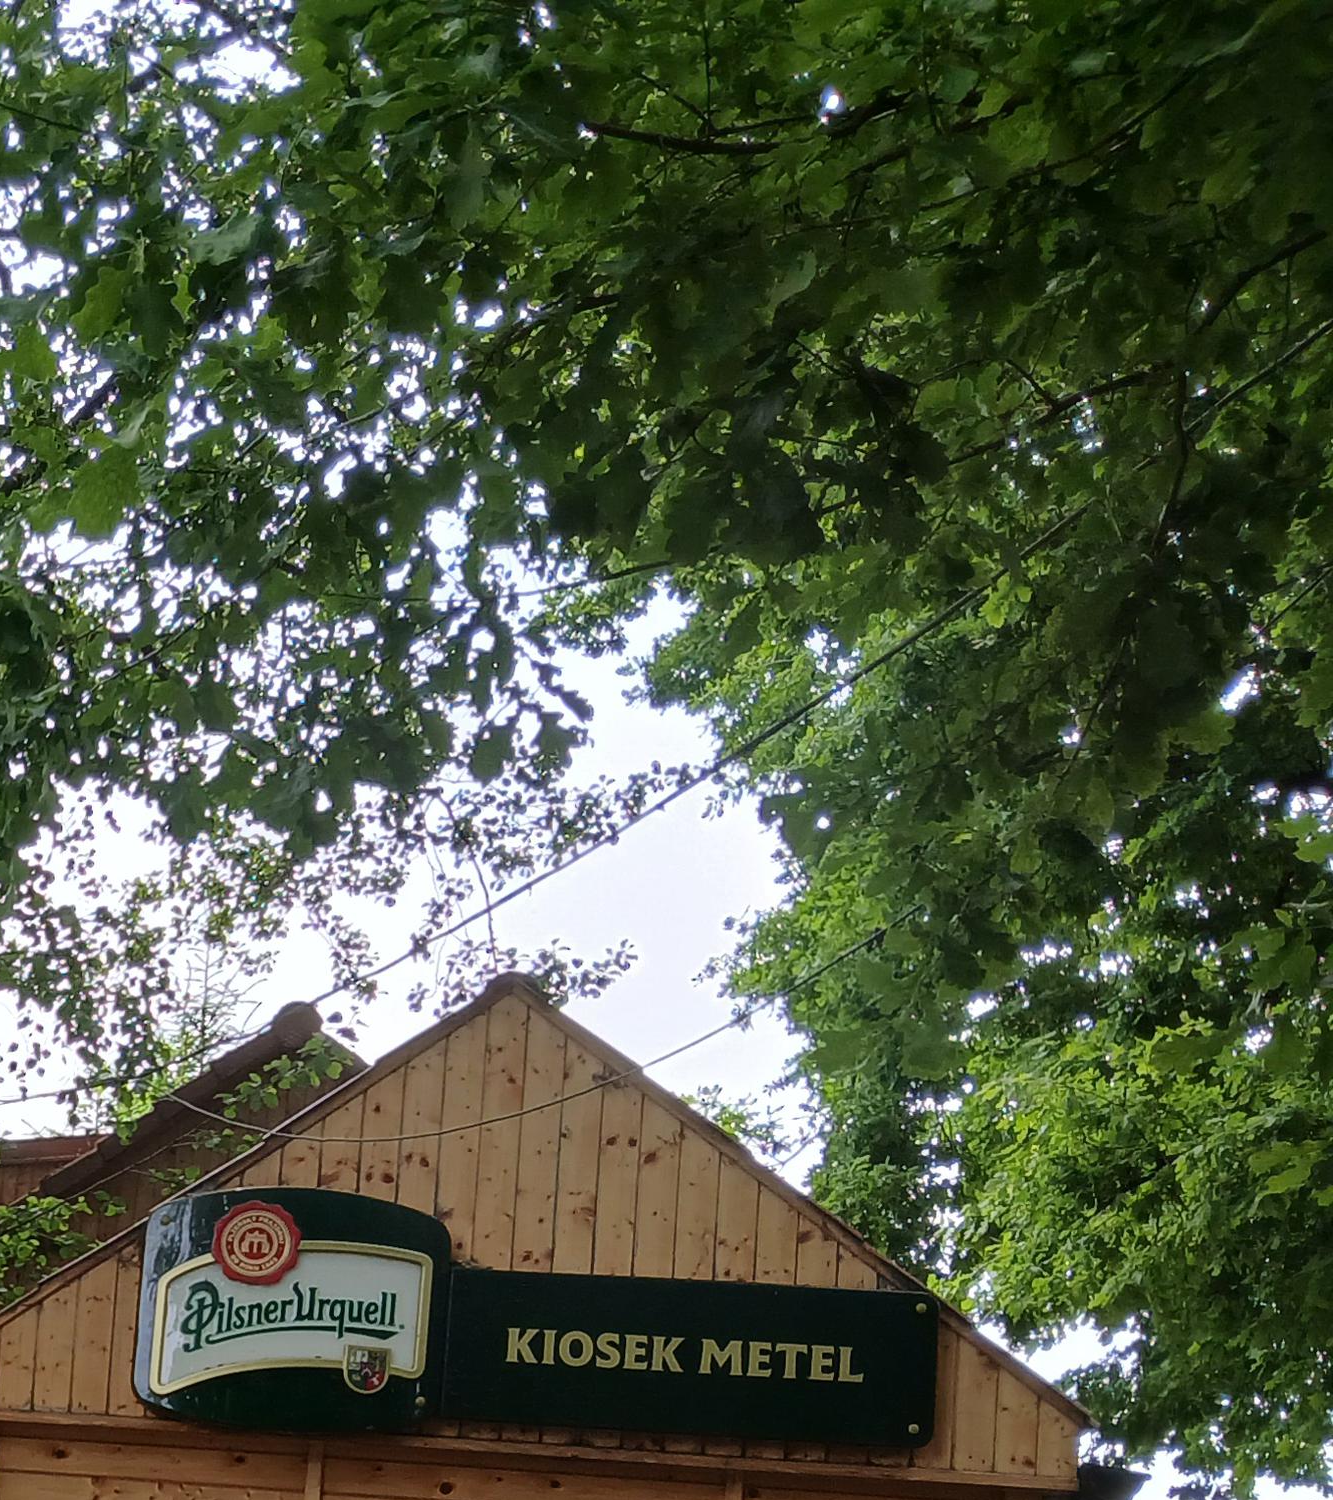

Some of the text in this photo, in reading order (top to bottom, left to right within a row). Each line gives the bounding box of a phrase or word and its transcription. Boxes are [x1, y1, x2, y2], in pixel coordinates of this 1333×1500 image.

[181, 1280, 397, 1352] Pilsner Urquell
[505, 1327, 864, 1383] KIOSEK METEL
